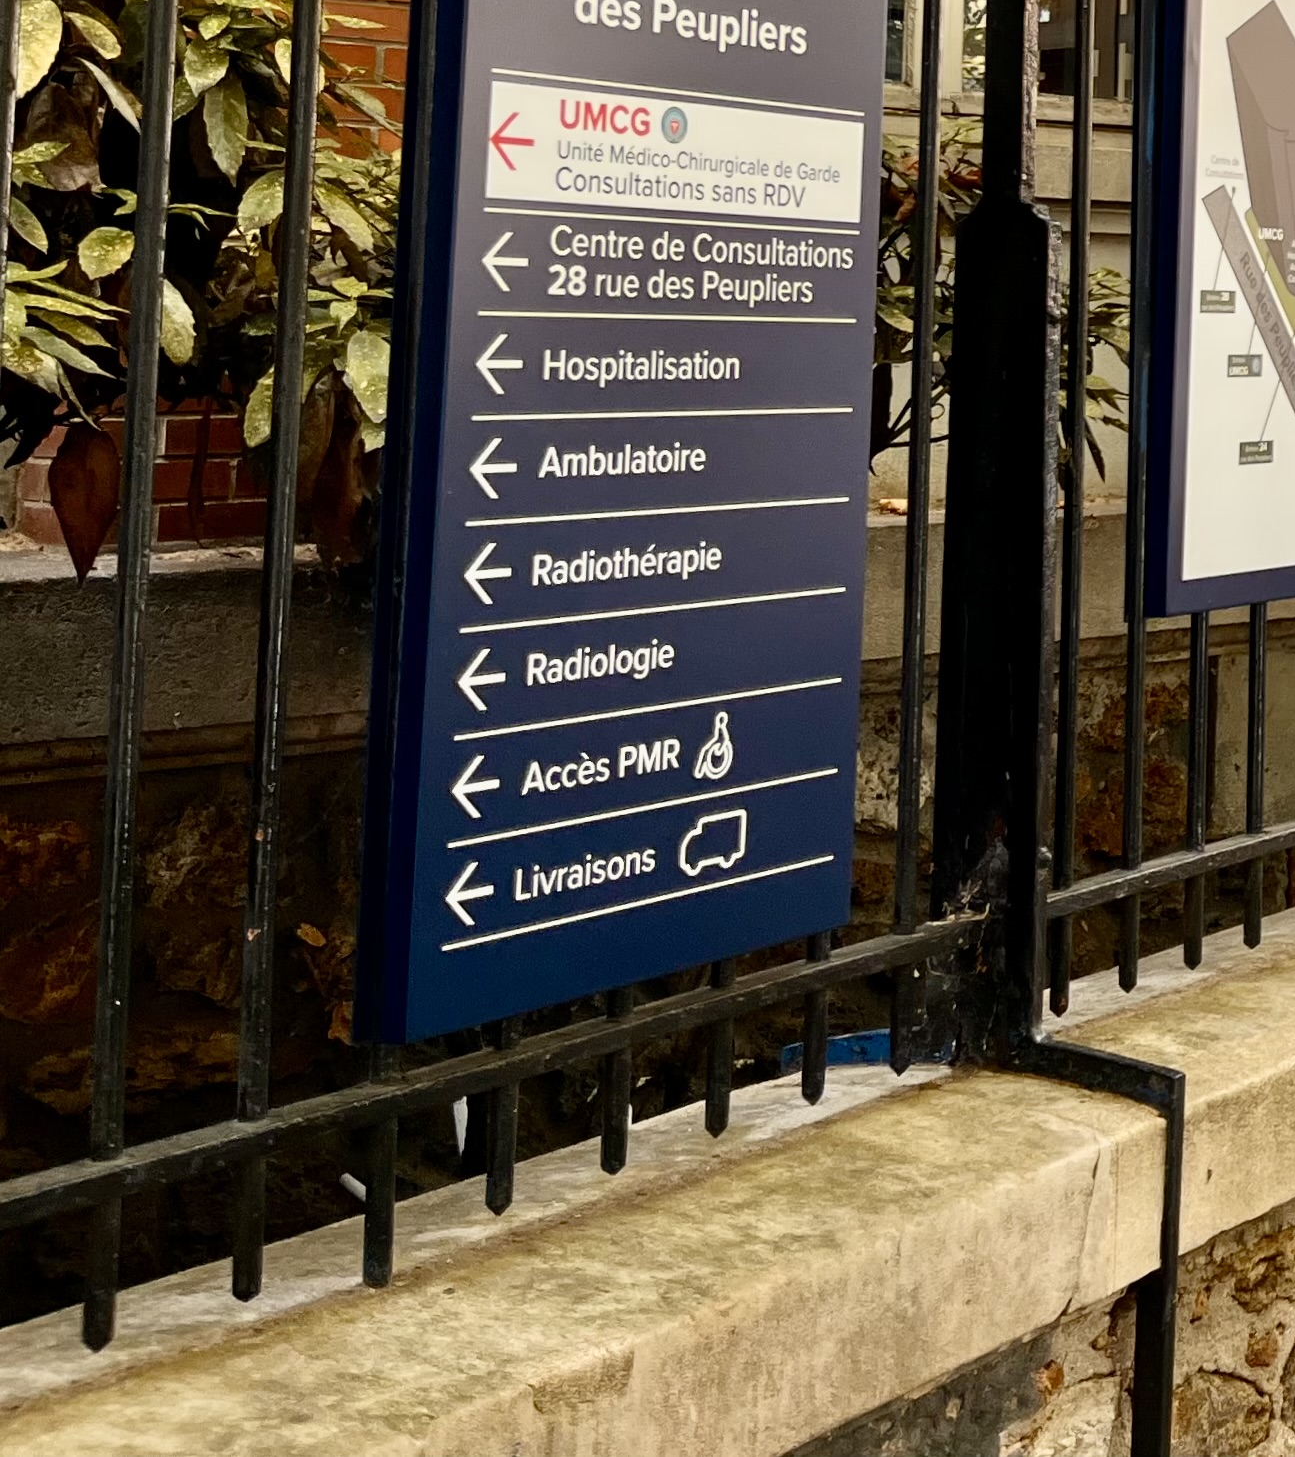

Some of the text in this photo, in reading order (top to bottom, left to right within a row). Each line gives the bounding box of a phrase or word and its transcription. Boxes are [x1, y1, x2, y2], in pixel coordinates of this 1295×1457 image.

[559, 99, 651, 137] UMCG
[556, 141, 841, 185] Unité Médico-Chirurgicale de Garde
[555, 165, 806, 209] Consultations sans RDV
[550, 224, 854, 269] Centre de Consultations
[1258, 227, 1284, 241] UMCG
[547, 264, 813, 308] 28 rue des Peupliers
[542, 349, 741, 388] Hospitalisation
[538, 441, 707, 479] Ambulatoire
[531, 541, 723, 587] Radiothérapie
[525, 638, 675, 686] Radiologie
[520, 738, 681, 796] Accès PMR
[513, 847, 657, 902] Livraisons
